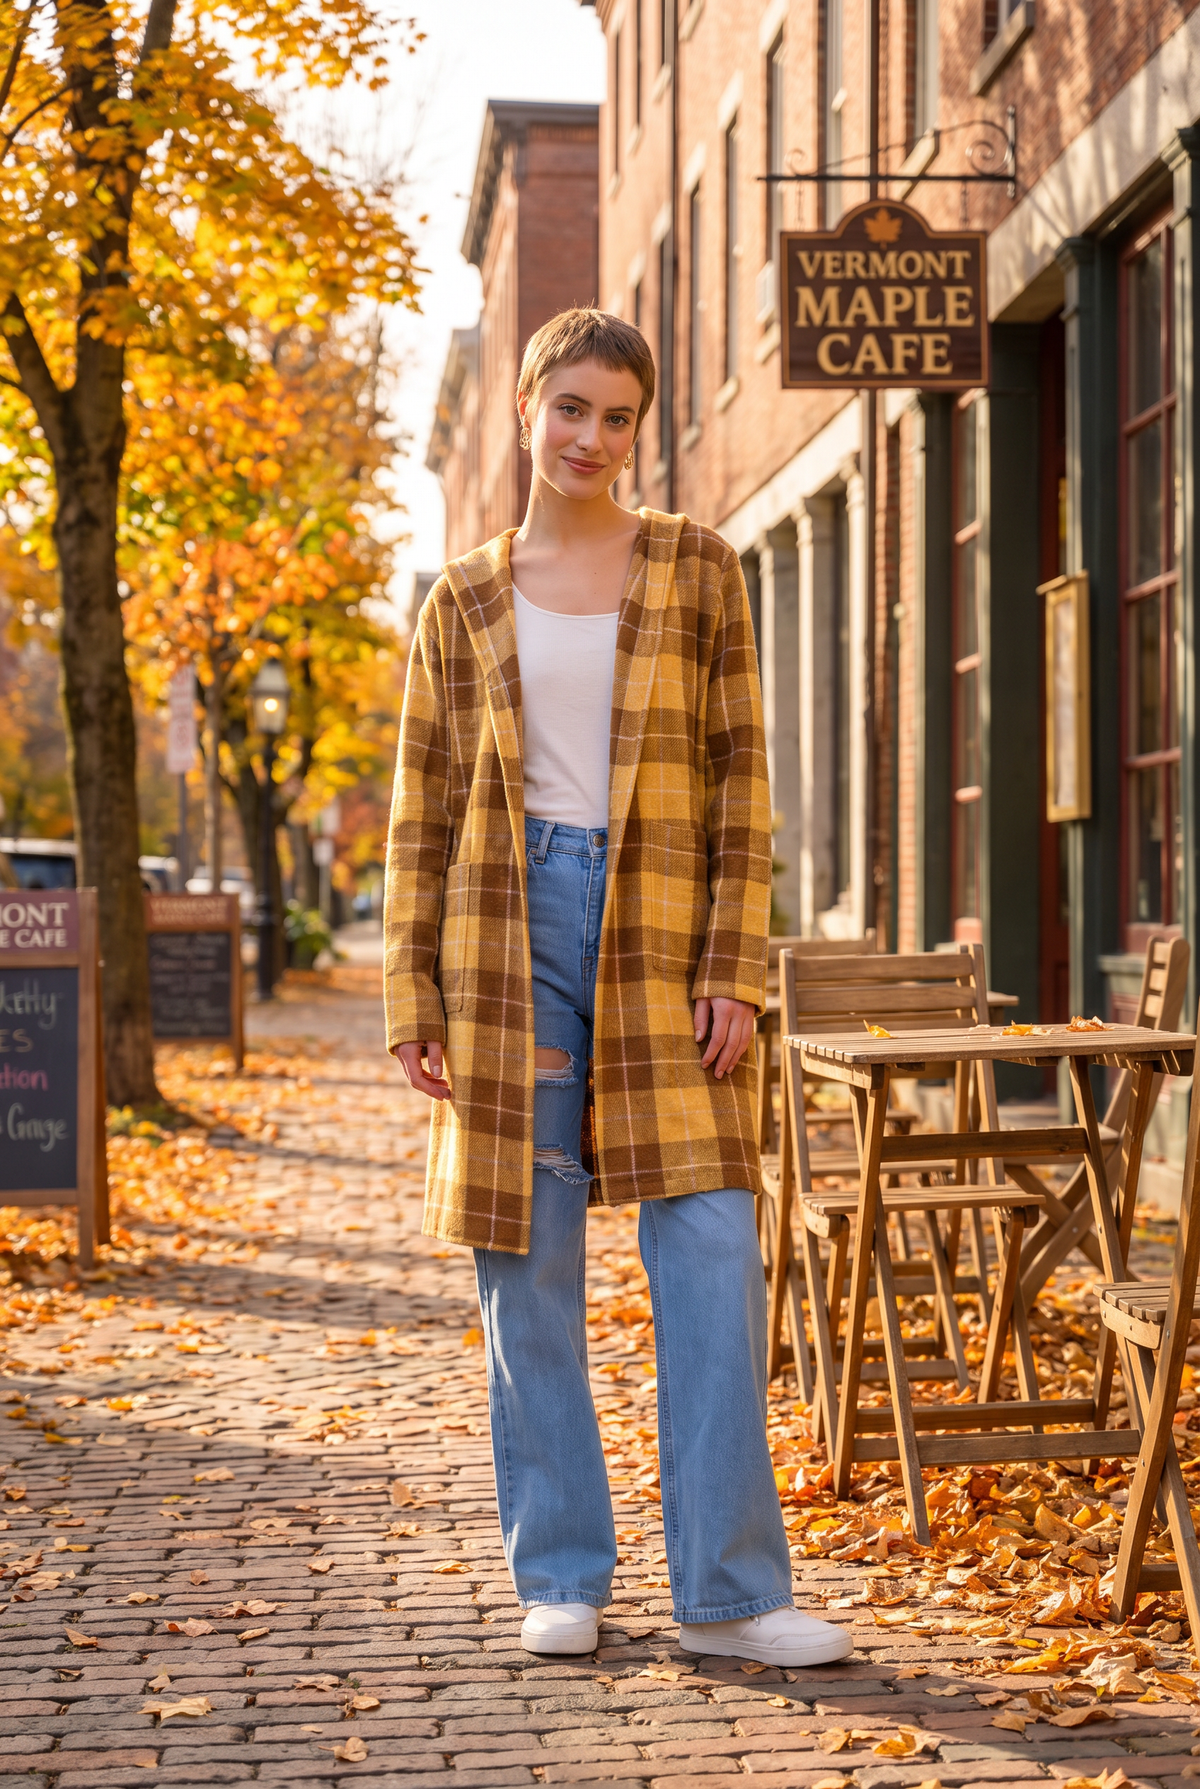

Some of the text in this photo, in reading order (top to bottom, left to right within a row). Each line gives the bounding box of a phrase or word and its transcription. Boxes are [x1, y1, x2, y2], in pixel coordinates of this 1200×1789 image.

[796, 250, 971, 280] VERMONT
[795, 286, 975, 328] MAPLE
[817, 333, 953, 376] CAFE
[0, 902, 69, 928] ONT
[14, 929, 67, 948] CAFE
